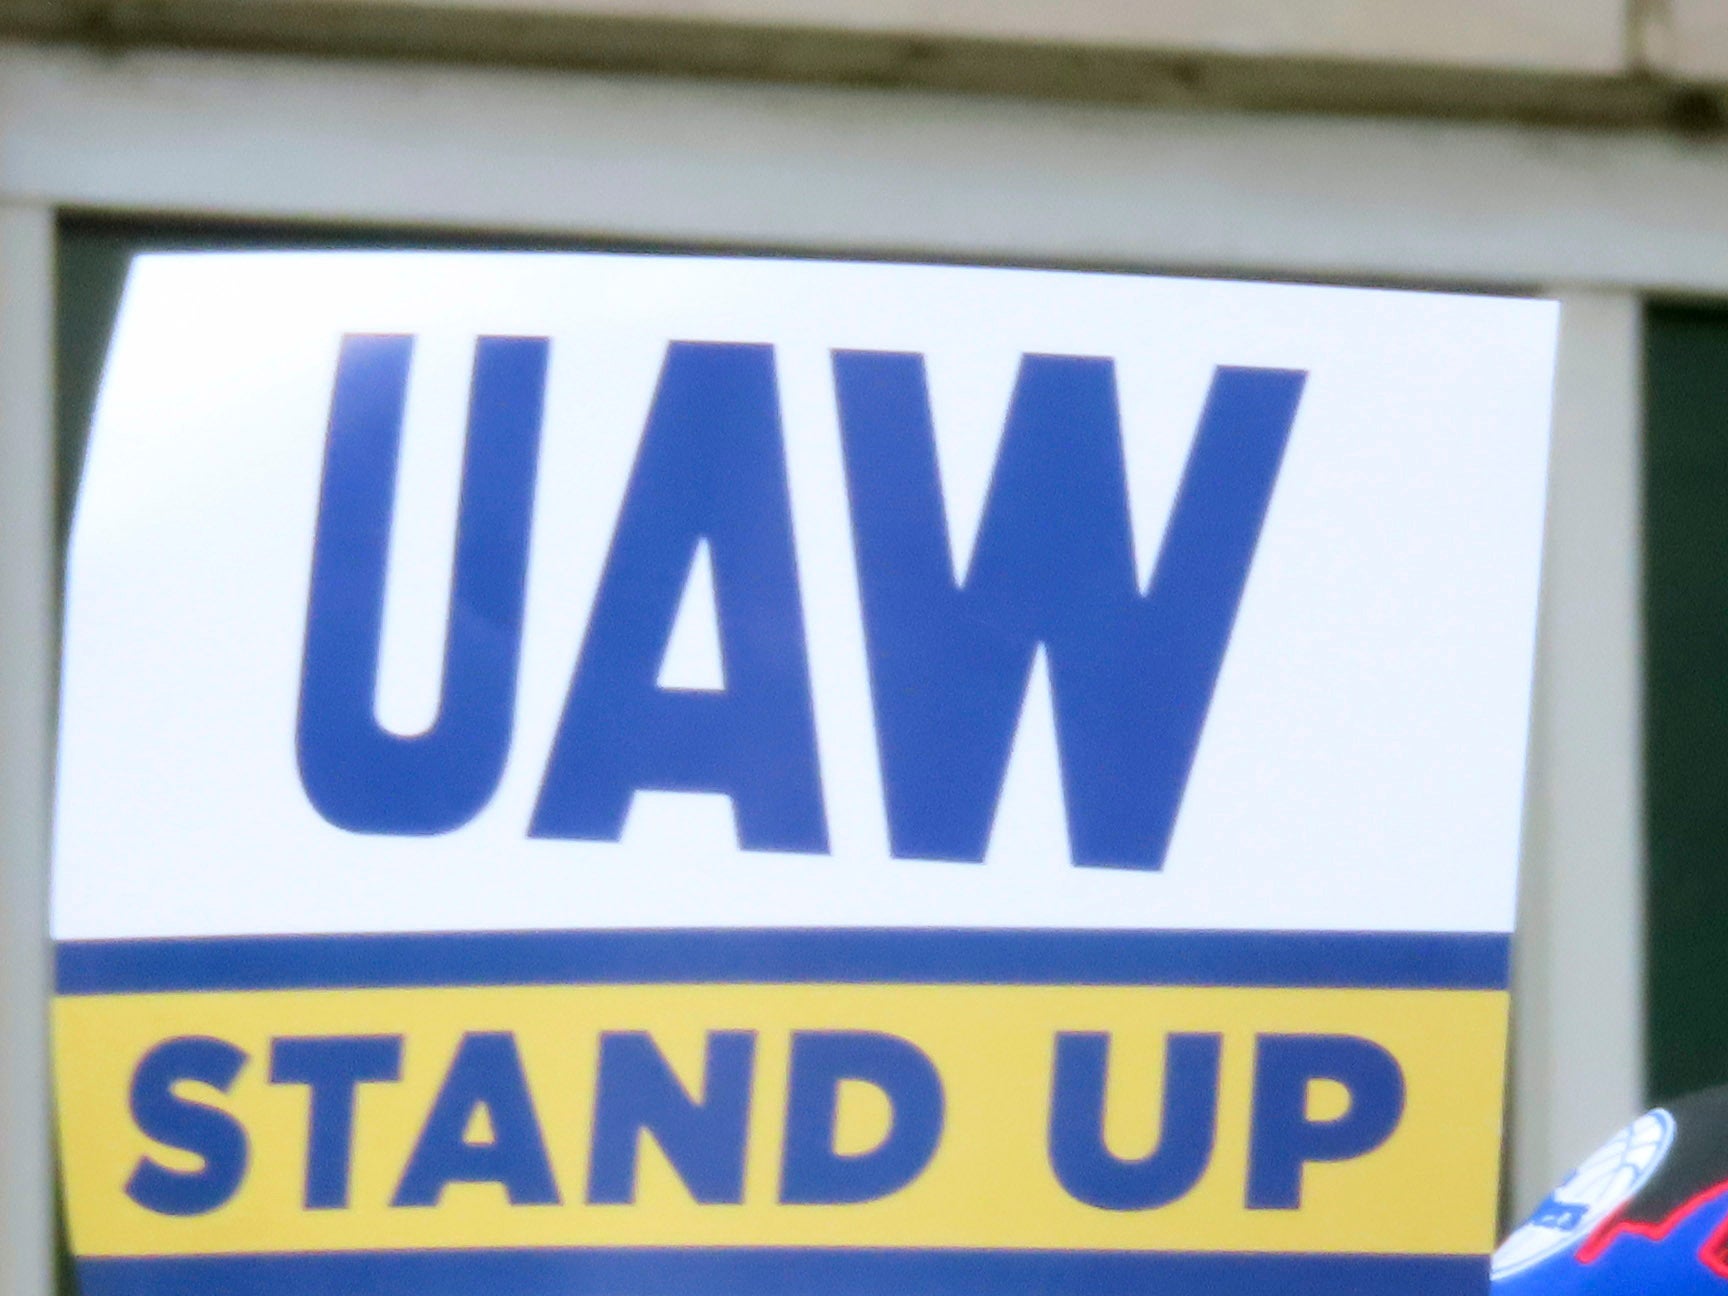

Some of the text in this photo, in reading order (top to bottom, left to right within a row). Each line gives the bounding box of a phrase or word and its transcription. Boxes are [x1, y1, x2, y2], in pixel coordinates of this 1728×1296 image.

[294, 331, 1309, 873] UAW
[122, 1026, 1408, 1217] STAND UP
